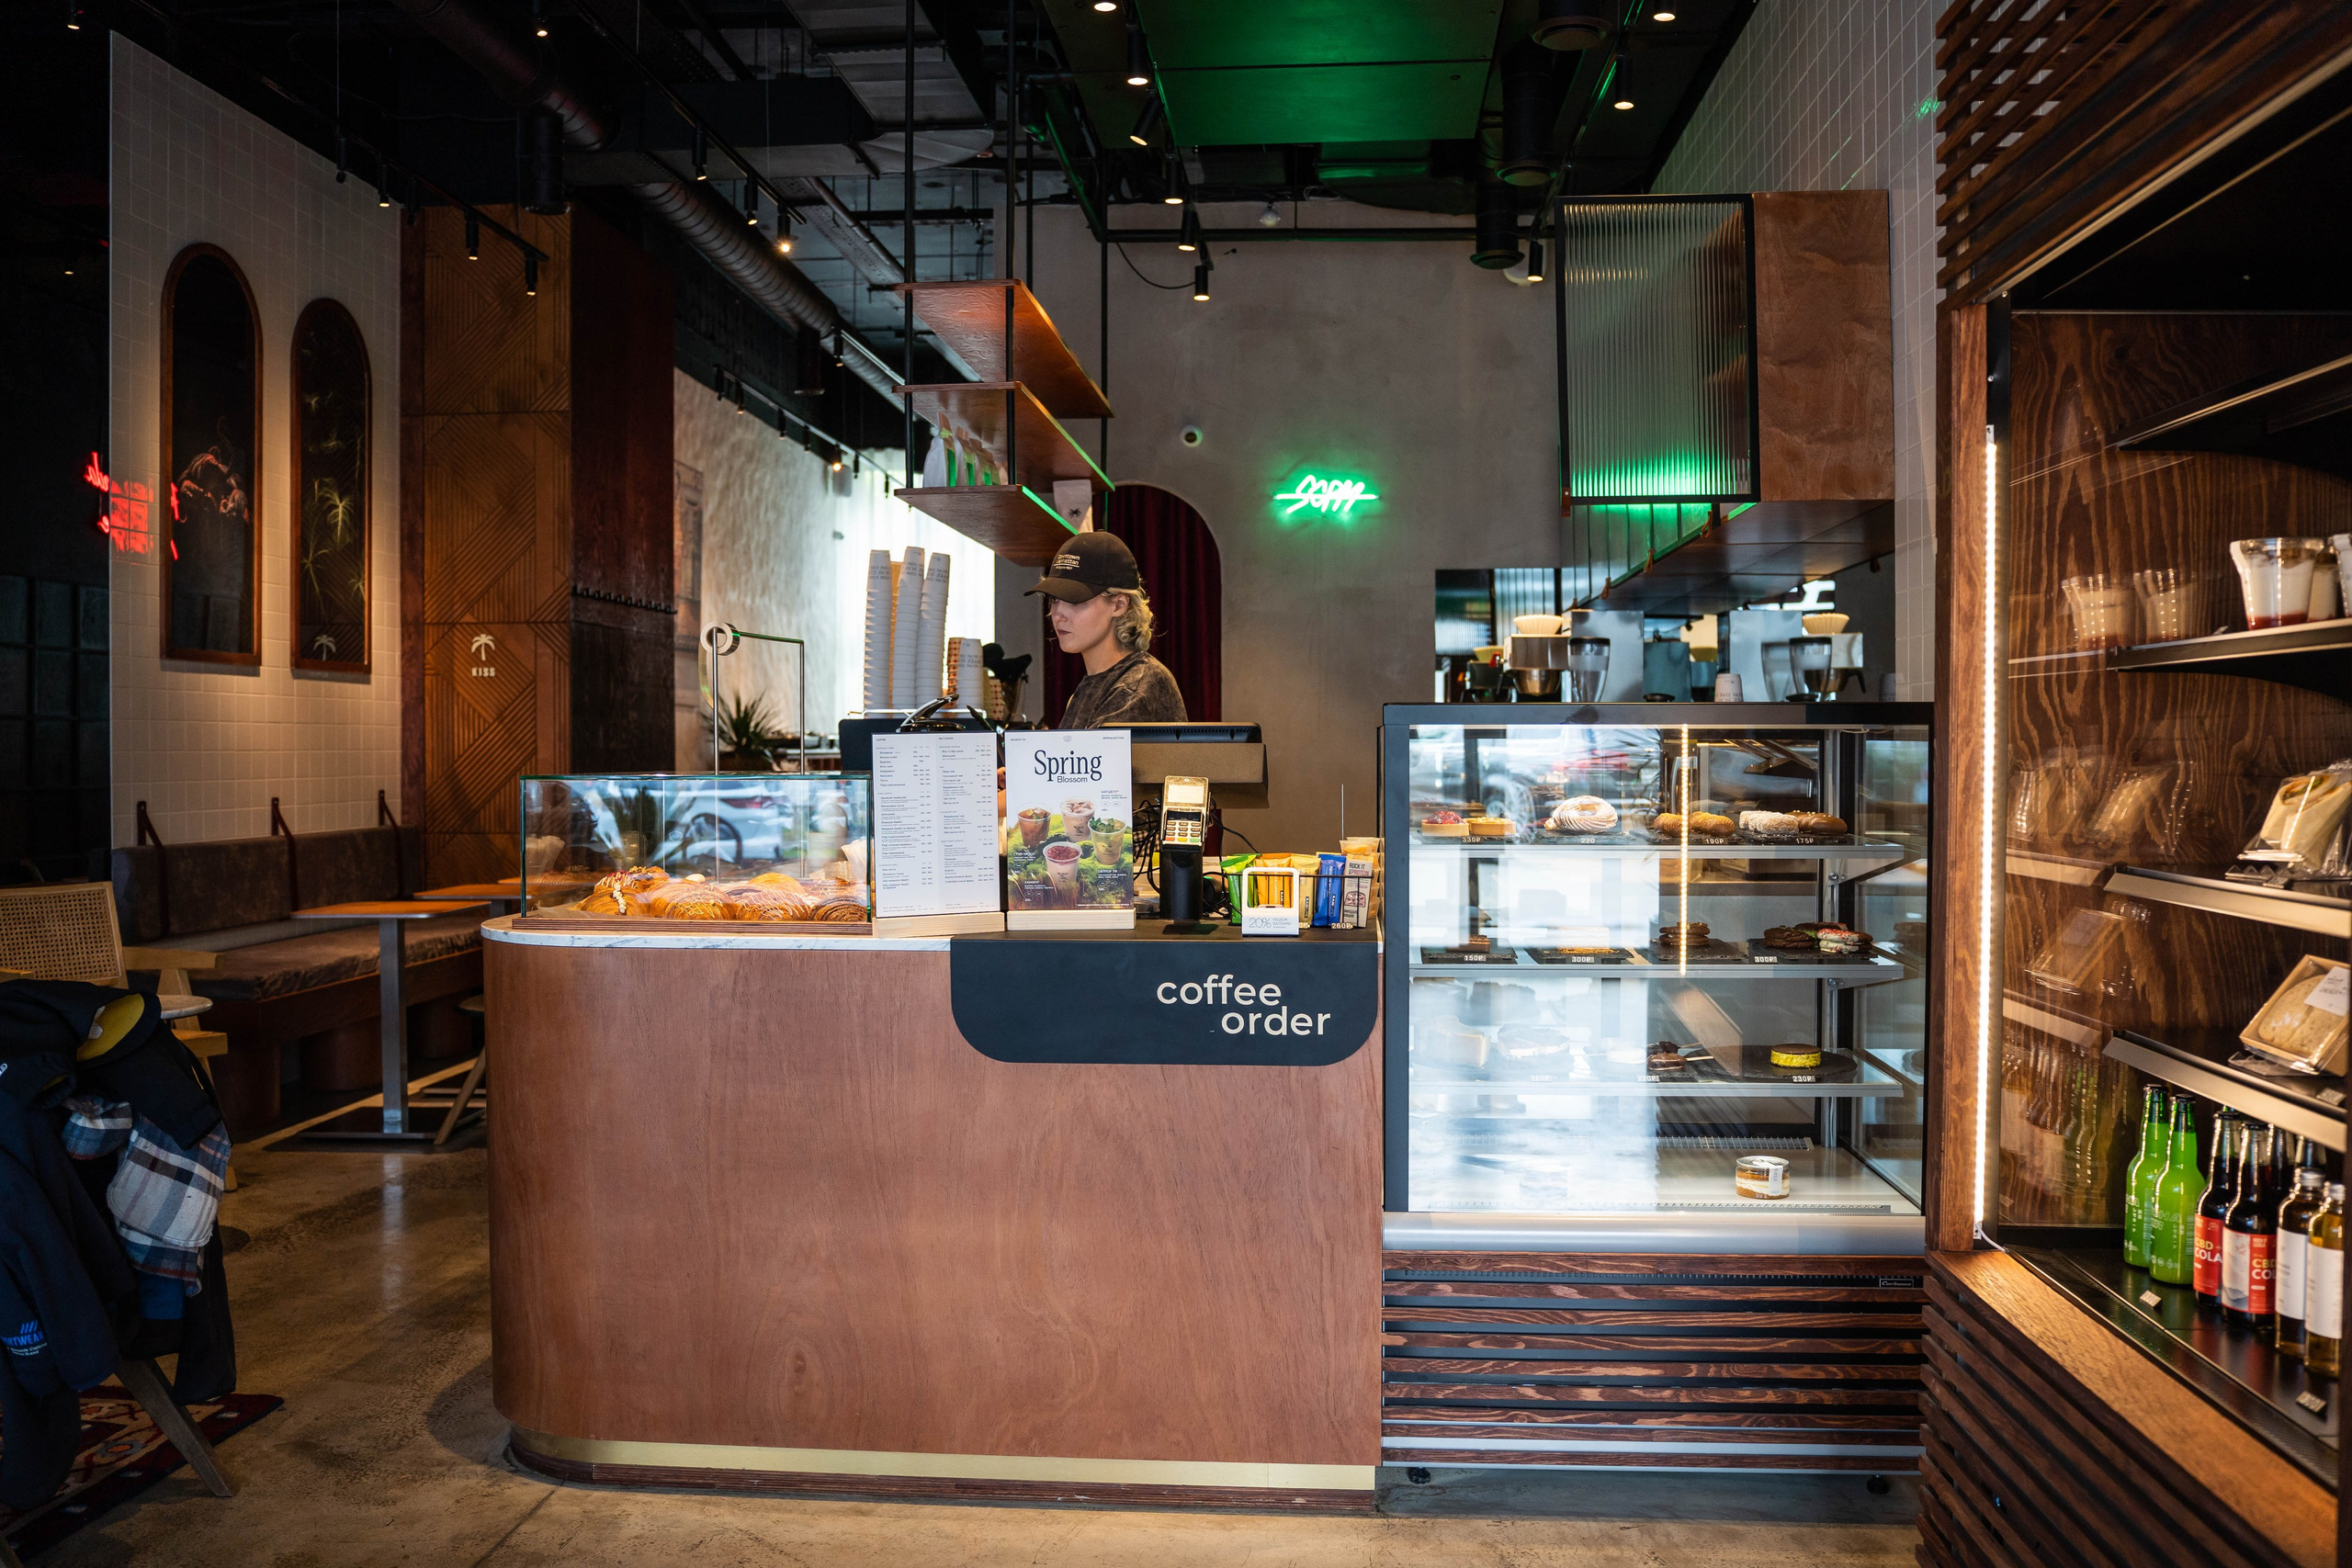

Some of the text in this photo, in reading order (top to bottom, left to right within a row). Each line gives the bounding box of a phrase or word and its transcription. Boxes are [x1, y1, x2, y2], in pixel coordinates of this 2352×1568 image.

[471, 667, 496, 677] KISS
[1034, 750, 1102, 782] Spring
[1249, 917, 1272, 929] 20%
[1157, 974, 1282, 1006] coffee
[1221, 1005, 1331, 1036] order
[2195, 1237, 2214, 1250] CBD
[2194, 1247, 2222, 1263] COLA
[2251, 1269, 2276, 1280] COL
